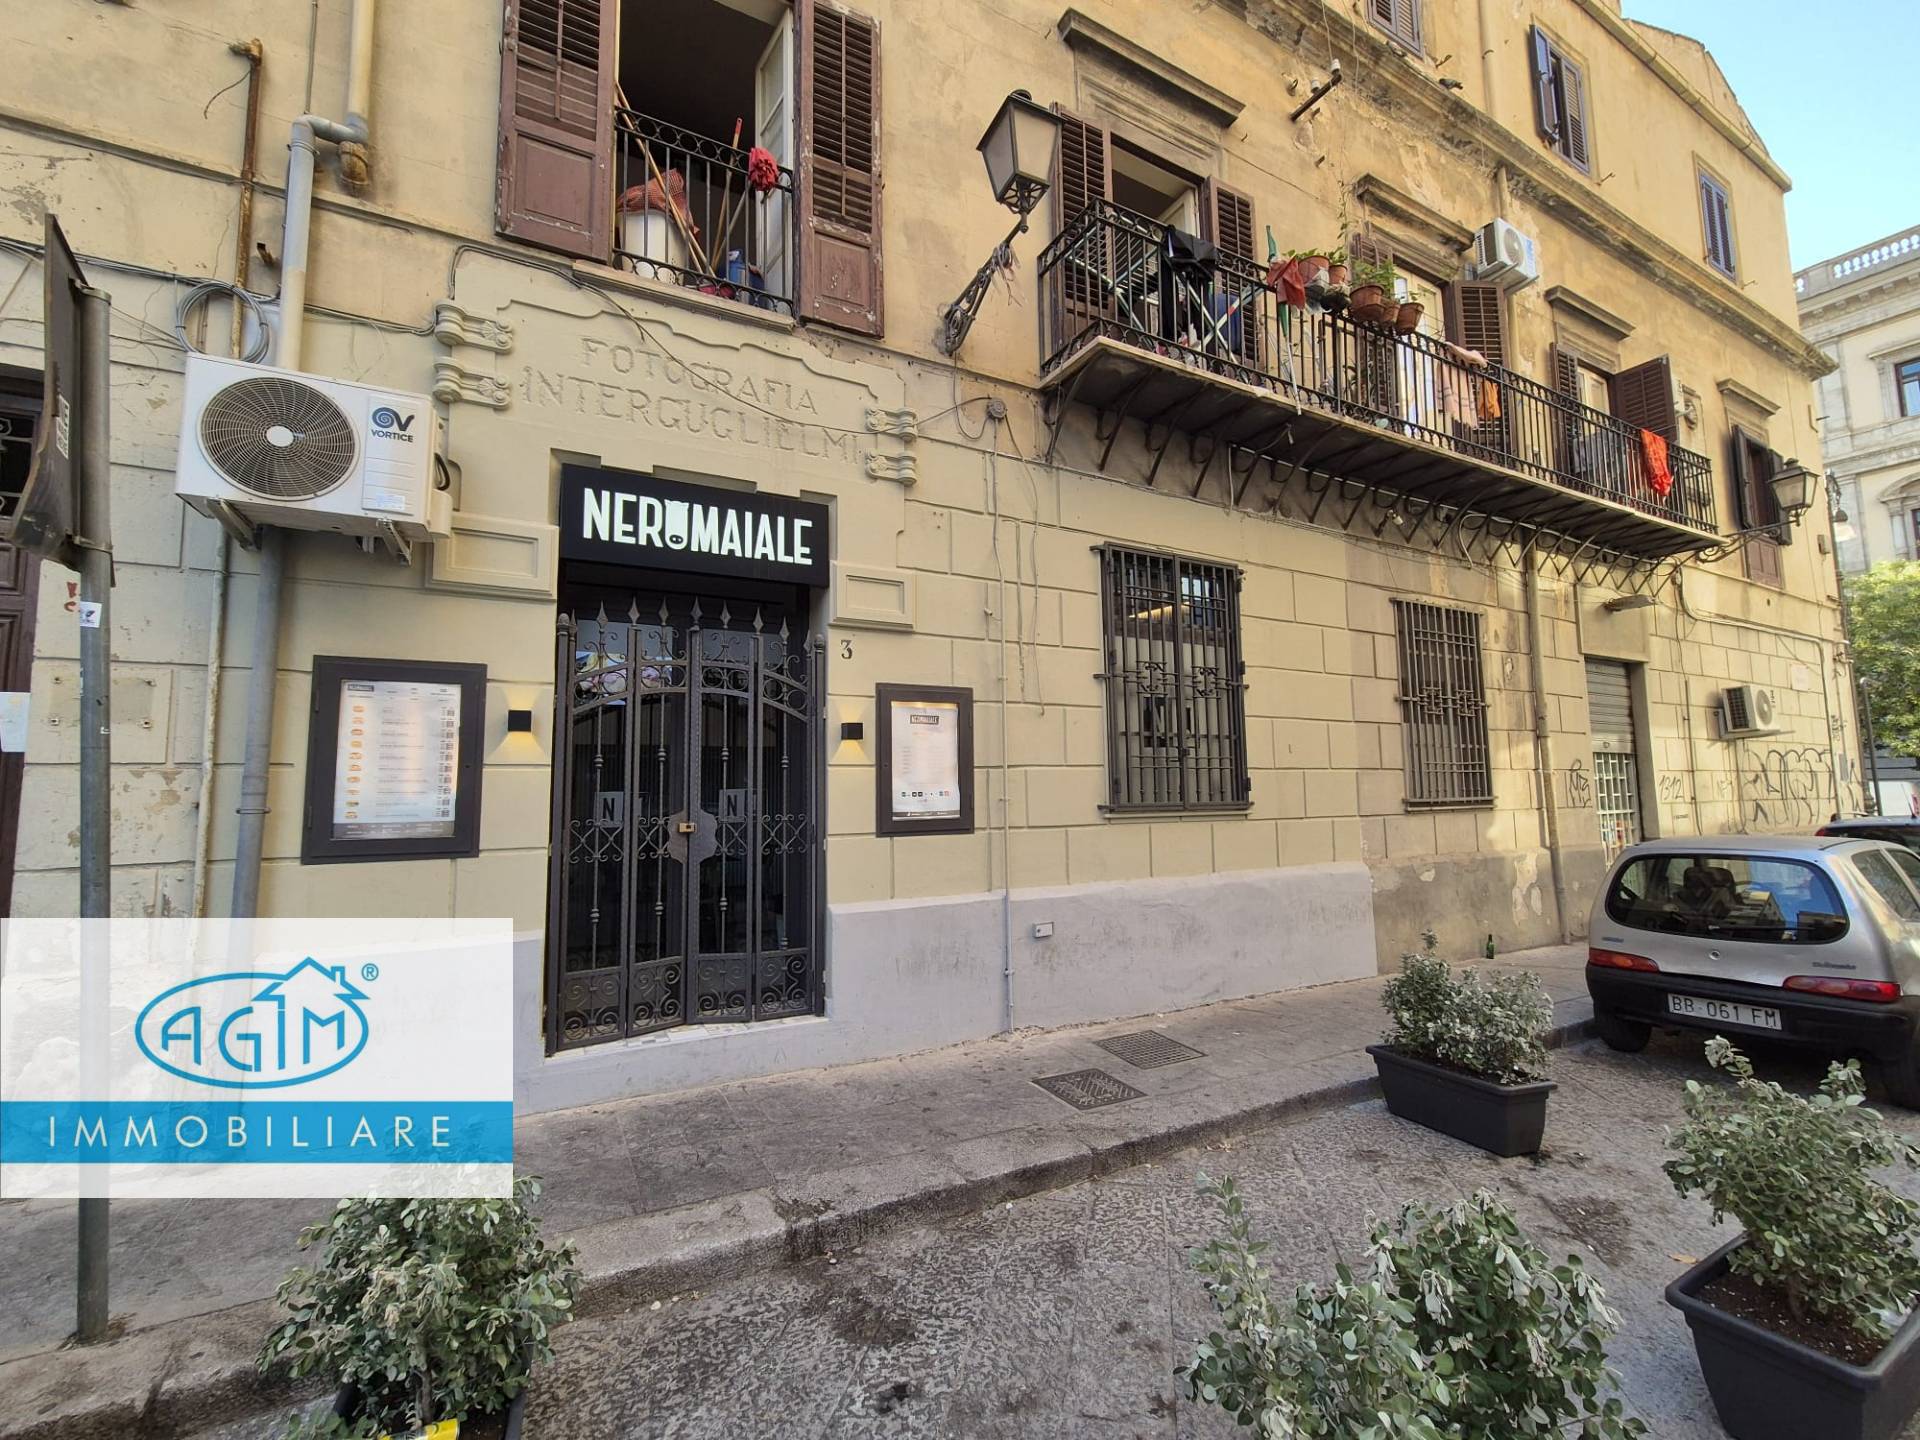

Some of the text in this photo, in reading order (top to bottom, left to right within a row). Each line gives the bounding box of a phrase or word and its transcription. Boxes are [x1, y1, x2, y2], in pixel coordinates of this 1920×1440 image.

[580, 338, 818, 415] FOTOGRAFIA
[371, 429, 414, 443] VORTICE
[840, 639, 853, 660] 3
[1751, 1008, 1778, 1028] FM
